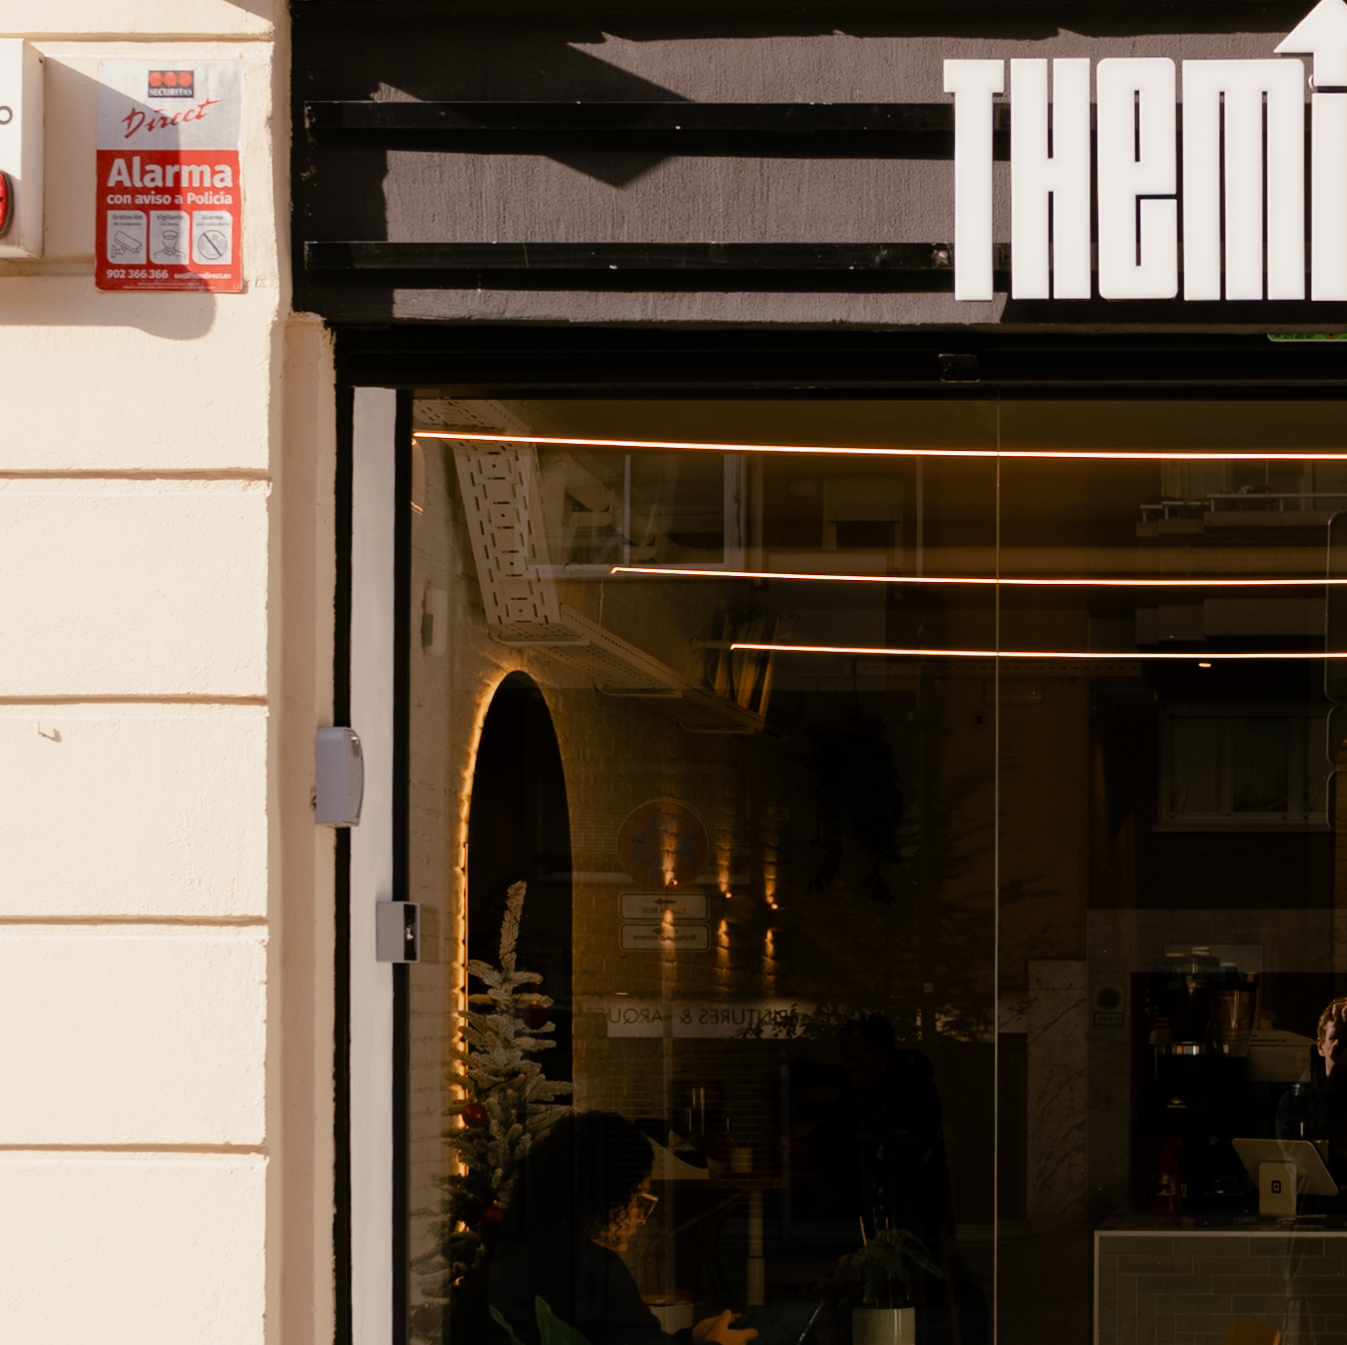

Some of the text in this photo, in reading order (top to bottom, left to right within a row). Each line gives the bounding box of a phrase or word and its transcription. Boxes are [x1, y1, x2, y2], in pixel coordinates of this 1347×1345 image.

[149, 88, 193, 96] SECURITAS
[121, 97, 222, 139] Direct
[106, 155, 233, 188] Alarma
[106, 190, 233, 205] con aviso a Policía
[106, 269, 169, 279] 902 366 366
